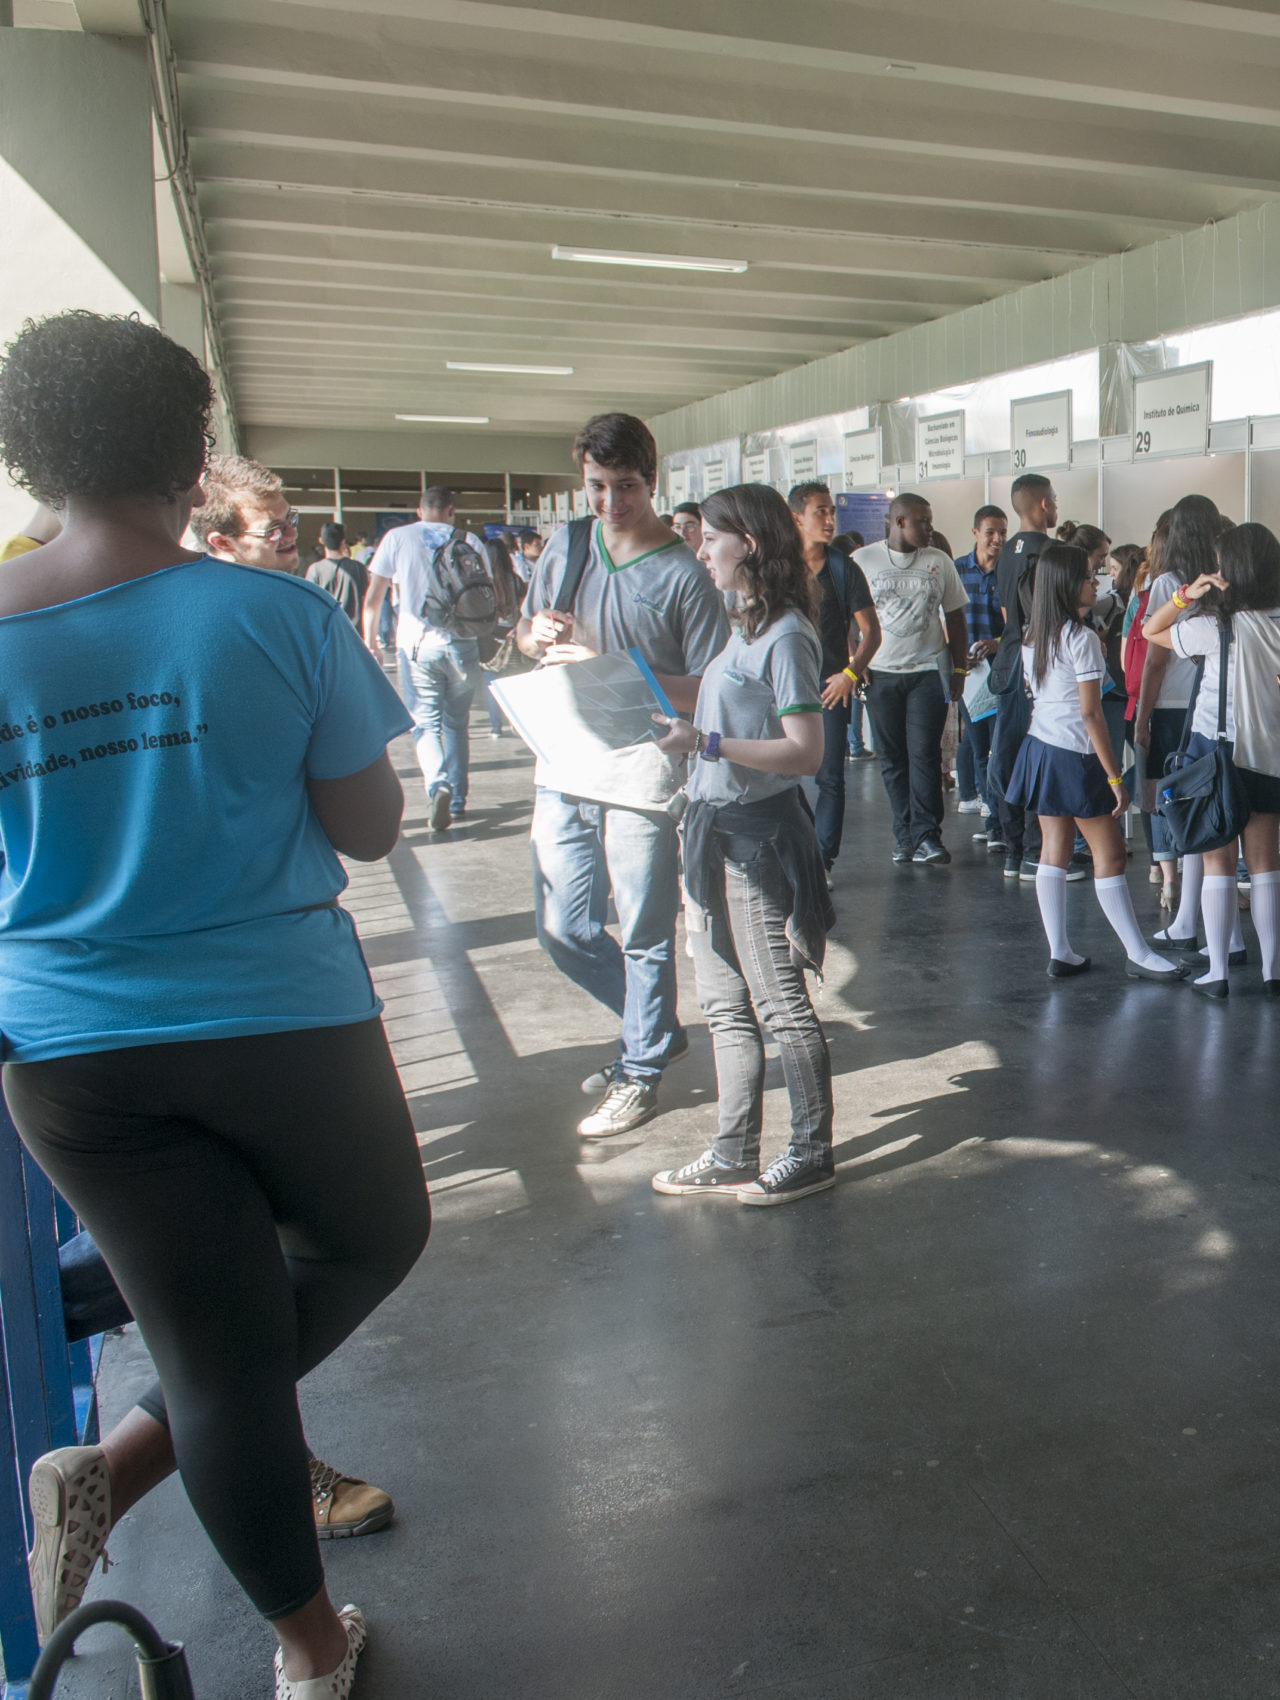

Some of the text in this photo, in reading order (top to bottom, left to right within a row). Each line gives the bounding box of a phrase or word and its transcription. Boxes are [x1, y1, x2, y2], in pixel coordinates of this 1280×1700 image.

[1143, 407, 1167, 420] Instituto
[1168, 405, 1175, 416] de
[1135, 430, 1151, 453] 29
[919, 460, 928, 478] 31
[1014, 448, 1027, 469] 30
[0, 691, 181, 745] de é o nosso foco,
[0, 753, 76, 791] ividade,
[78, 736, 138, 763] nosso
